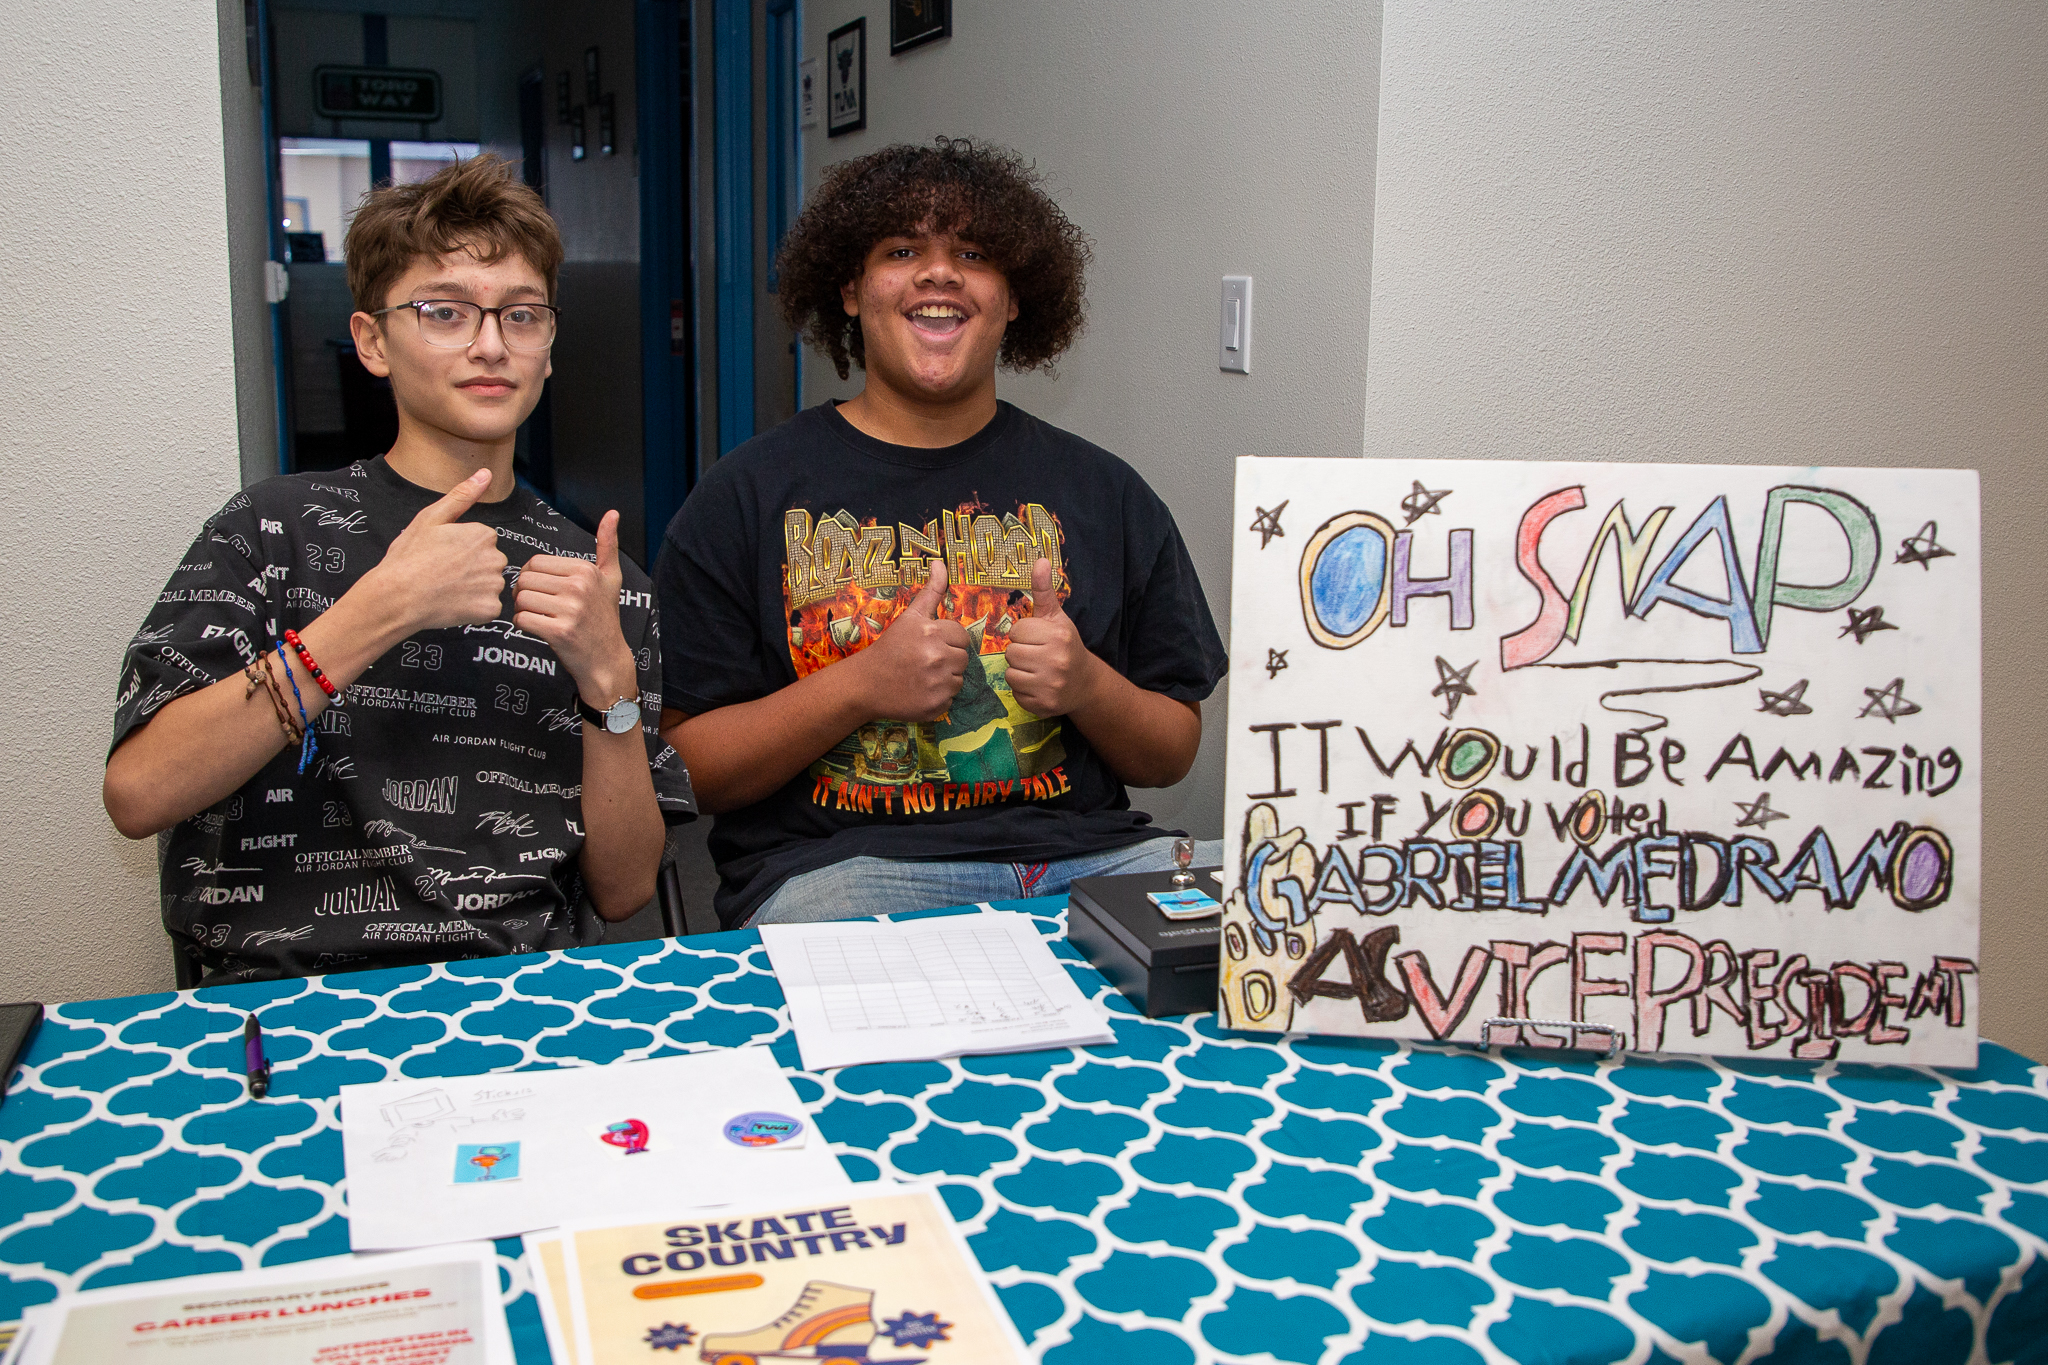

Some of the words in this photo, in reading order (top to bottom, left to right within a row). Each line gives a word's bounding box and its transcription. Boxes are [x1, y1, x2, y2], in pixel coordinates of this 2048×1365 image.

[260, 518, 283, 534] AIR
[305, 543, 345, 573] 23
[785, 508, 899, 610] BOYZ
[943, 503, 1063, 593] HOOD
[1299, 510, 1474, 649] OH
[1500, 484, 1882, 672] SNAP
[188, 589, 256, 616] MEMBER
[401, 641, 443, 671] 23
[472, 646, 556, 676] JORDAN
[361, 698, 405, 710] JORDAN
[409, 703, 446, 715] FLIGHT
[449, 707, 476, 718] CLUB
[413, 691, 477, 709] MEMBER
[494, 684, 530, 715] 23
[432, 733, 450, 743] AIR
[453, 735, 497, 747] JORDAN
[500, 739, 526, 753] FLIGHT
[528, 747, 547, 760] CLUB
[1247, 720, 1342, 800] IT
[1614, 731, 1687, 788] Be
[265, 788, 293, 803] AIR
[382, 775, 459, 814] JORDAN
[475, 770, 532, 794] OFFICIAL
[534, 782, 582, 799] MEMBE
[812, 775, 832, 807] IT
[835, 781, 896, 815] AIN'T
[902, 782, 936, 815] NO
[943, 779, 1015, 812] FAIRY
[1020, 766, 1072, 801] TALE
[1336, 794, 1400, 842] IF
[240, 833, 298, 851] FLIGHT
[294, 848, 361, 864] OFFICIAL
[361, 843, 412, 861] MEMBER
[295, 864, 313, 873] AIR
[316, 860, 359, 872] JORDAN
[362, 859, 387, 868] FLIGHT
[389, 855, 415, 866] CLUB
[1246, 837, 1549, 932] GABRIEL
[1550, 821, 1954, 923] MEDRANO
[313, 874, 400, 917] JORDAN
[362, 932, 381, 940] AIR
[385, 932, 431, 943] JORDAN
[435, 931, 475, 943] FLIGHT
[365, 922, 437, 934] OFFICIAL
[1287, 925, 1411, 1024] AS
[1394, 931, 1630, 1049] VICE
[1631, 928, 1979, 1060] PRESIDENT
[664, 1205, 857, 1248] SKATE
[621, 1222, 907, 1277] COUNTRY
[132, 1309, 272, 1333] CAREER
[277, 1287, 434, 1319] LUNCHES
